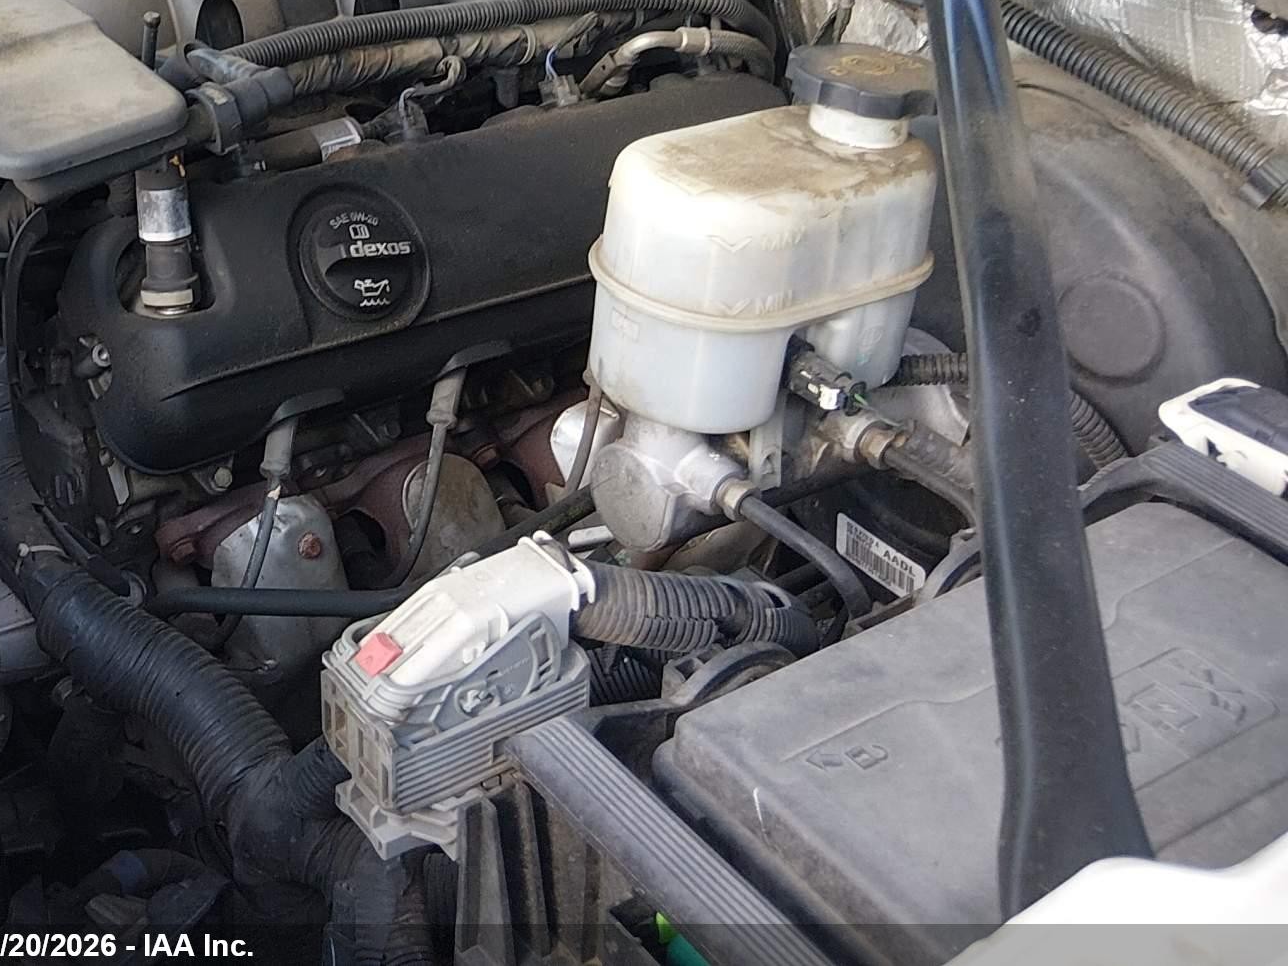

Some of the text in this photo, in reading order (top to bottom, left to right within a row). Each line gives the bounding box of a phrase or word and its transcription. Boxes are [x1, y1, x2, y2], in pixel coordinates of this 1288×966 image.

[329, 213, 350, 230] SAE
[349, 240, 411, 258] dexos
[883, 549, 917, 577] AADL
